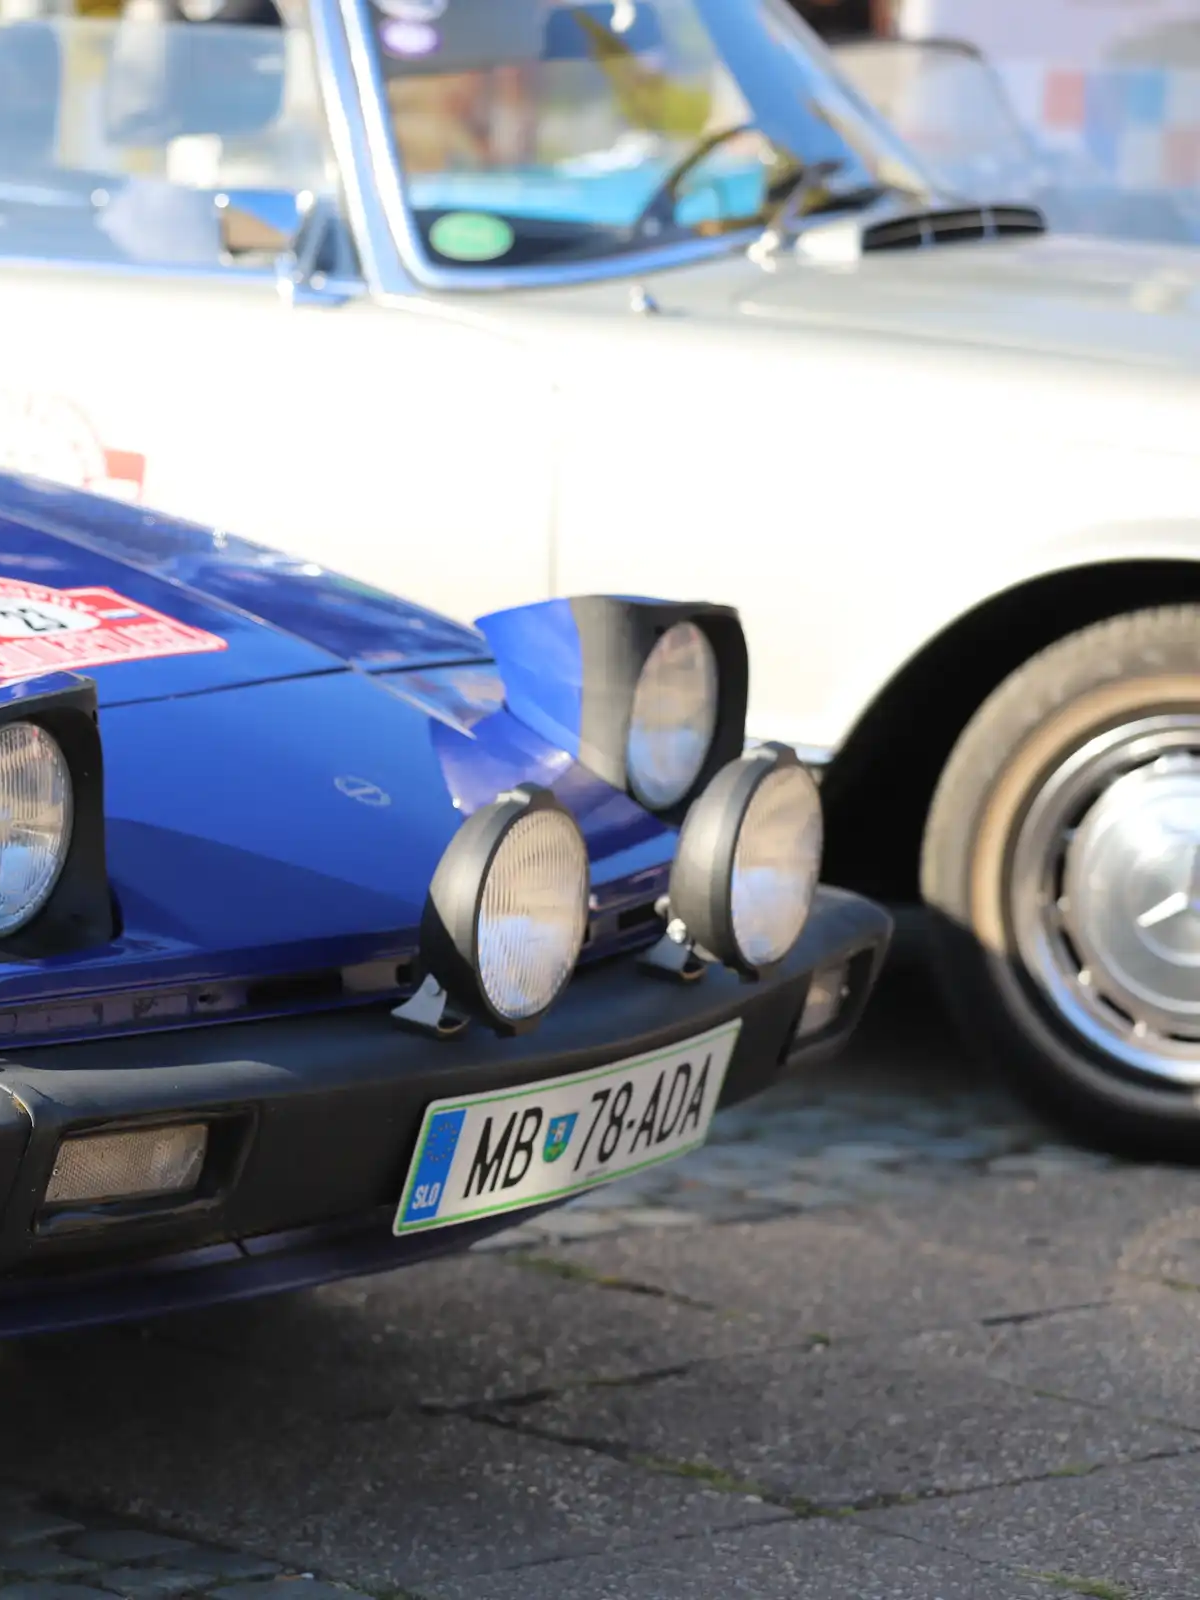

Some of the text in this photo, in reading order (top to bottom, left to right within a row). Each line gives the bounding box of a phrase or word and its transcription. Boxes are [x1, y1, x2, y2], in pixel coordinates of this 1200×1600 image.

[463, 1053, 713, 1198] MB 78-ADA
[412, 1184, 441, 1210] SLO
